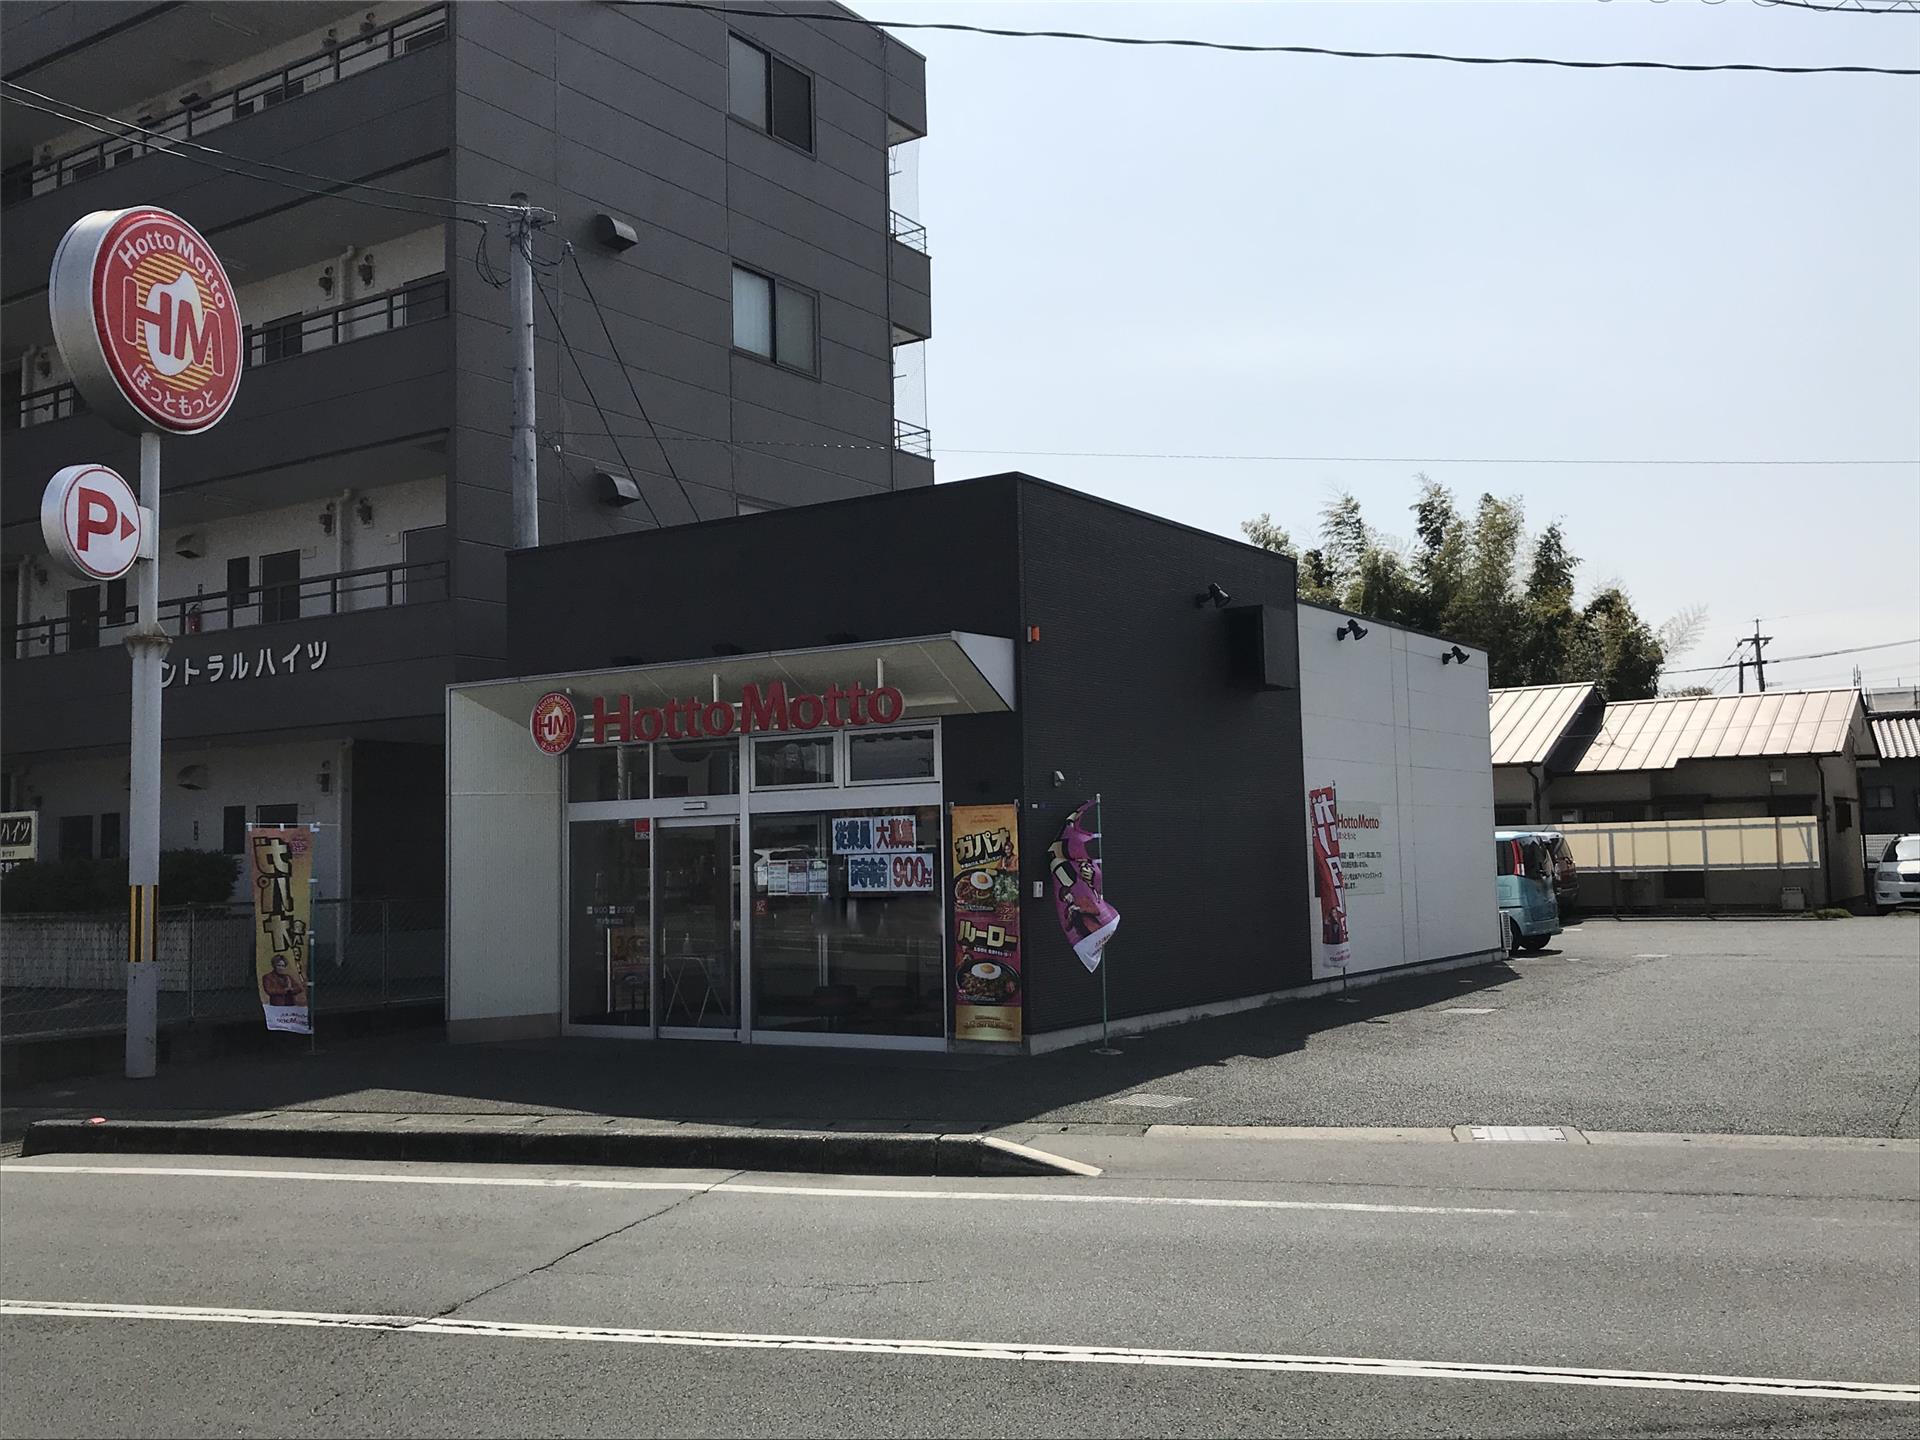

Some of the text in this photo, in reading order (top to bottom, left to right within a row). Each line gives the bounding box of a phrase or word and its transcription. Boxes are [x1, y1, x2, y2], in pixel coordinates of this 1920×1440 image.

[118, 231, 226, 310] Hotto Motto
[123, 275, 225, 377] HM
[132, 364, 217, 416] ほっともっと
[77, 486, 118, 552] P
[593, 680, 905, 745] Hotto Motto
[956, 828, 1010, 860] ガパオ
[1337, 814, 1380, 829] Hotto Motto
[958, 920, 1018, 948] ルーロー
